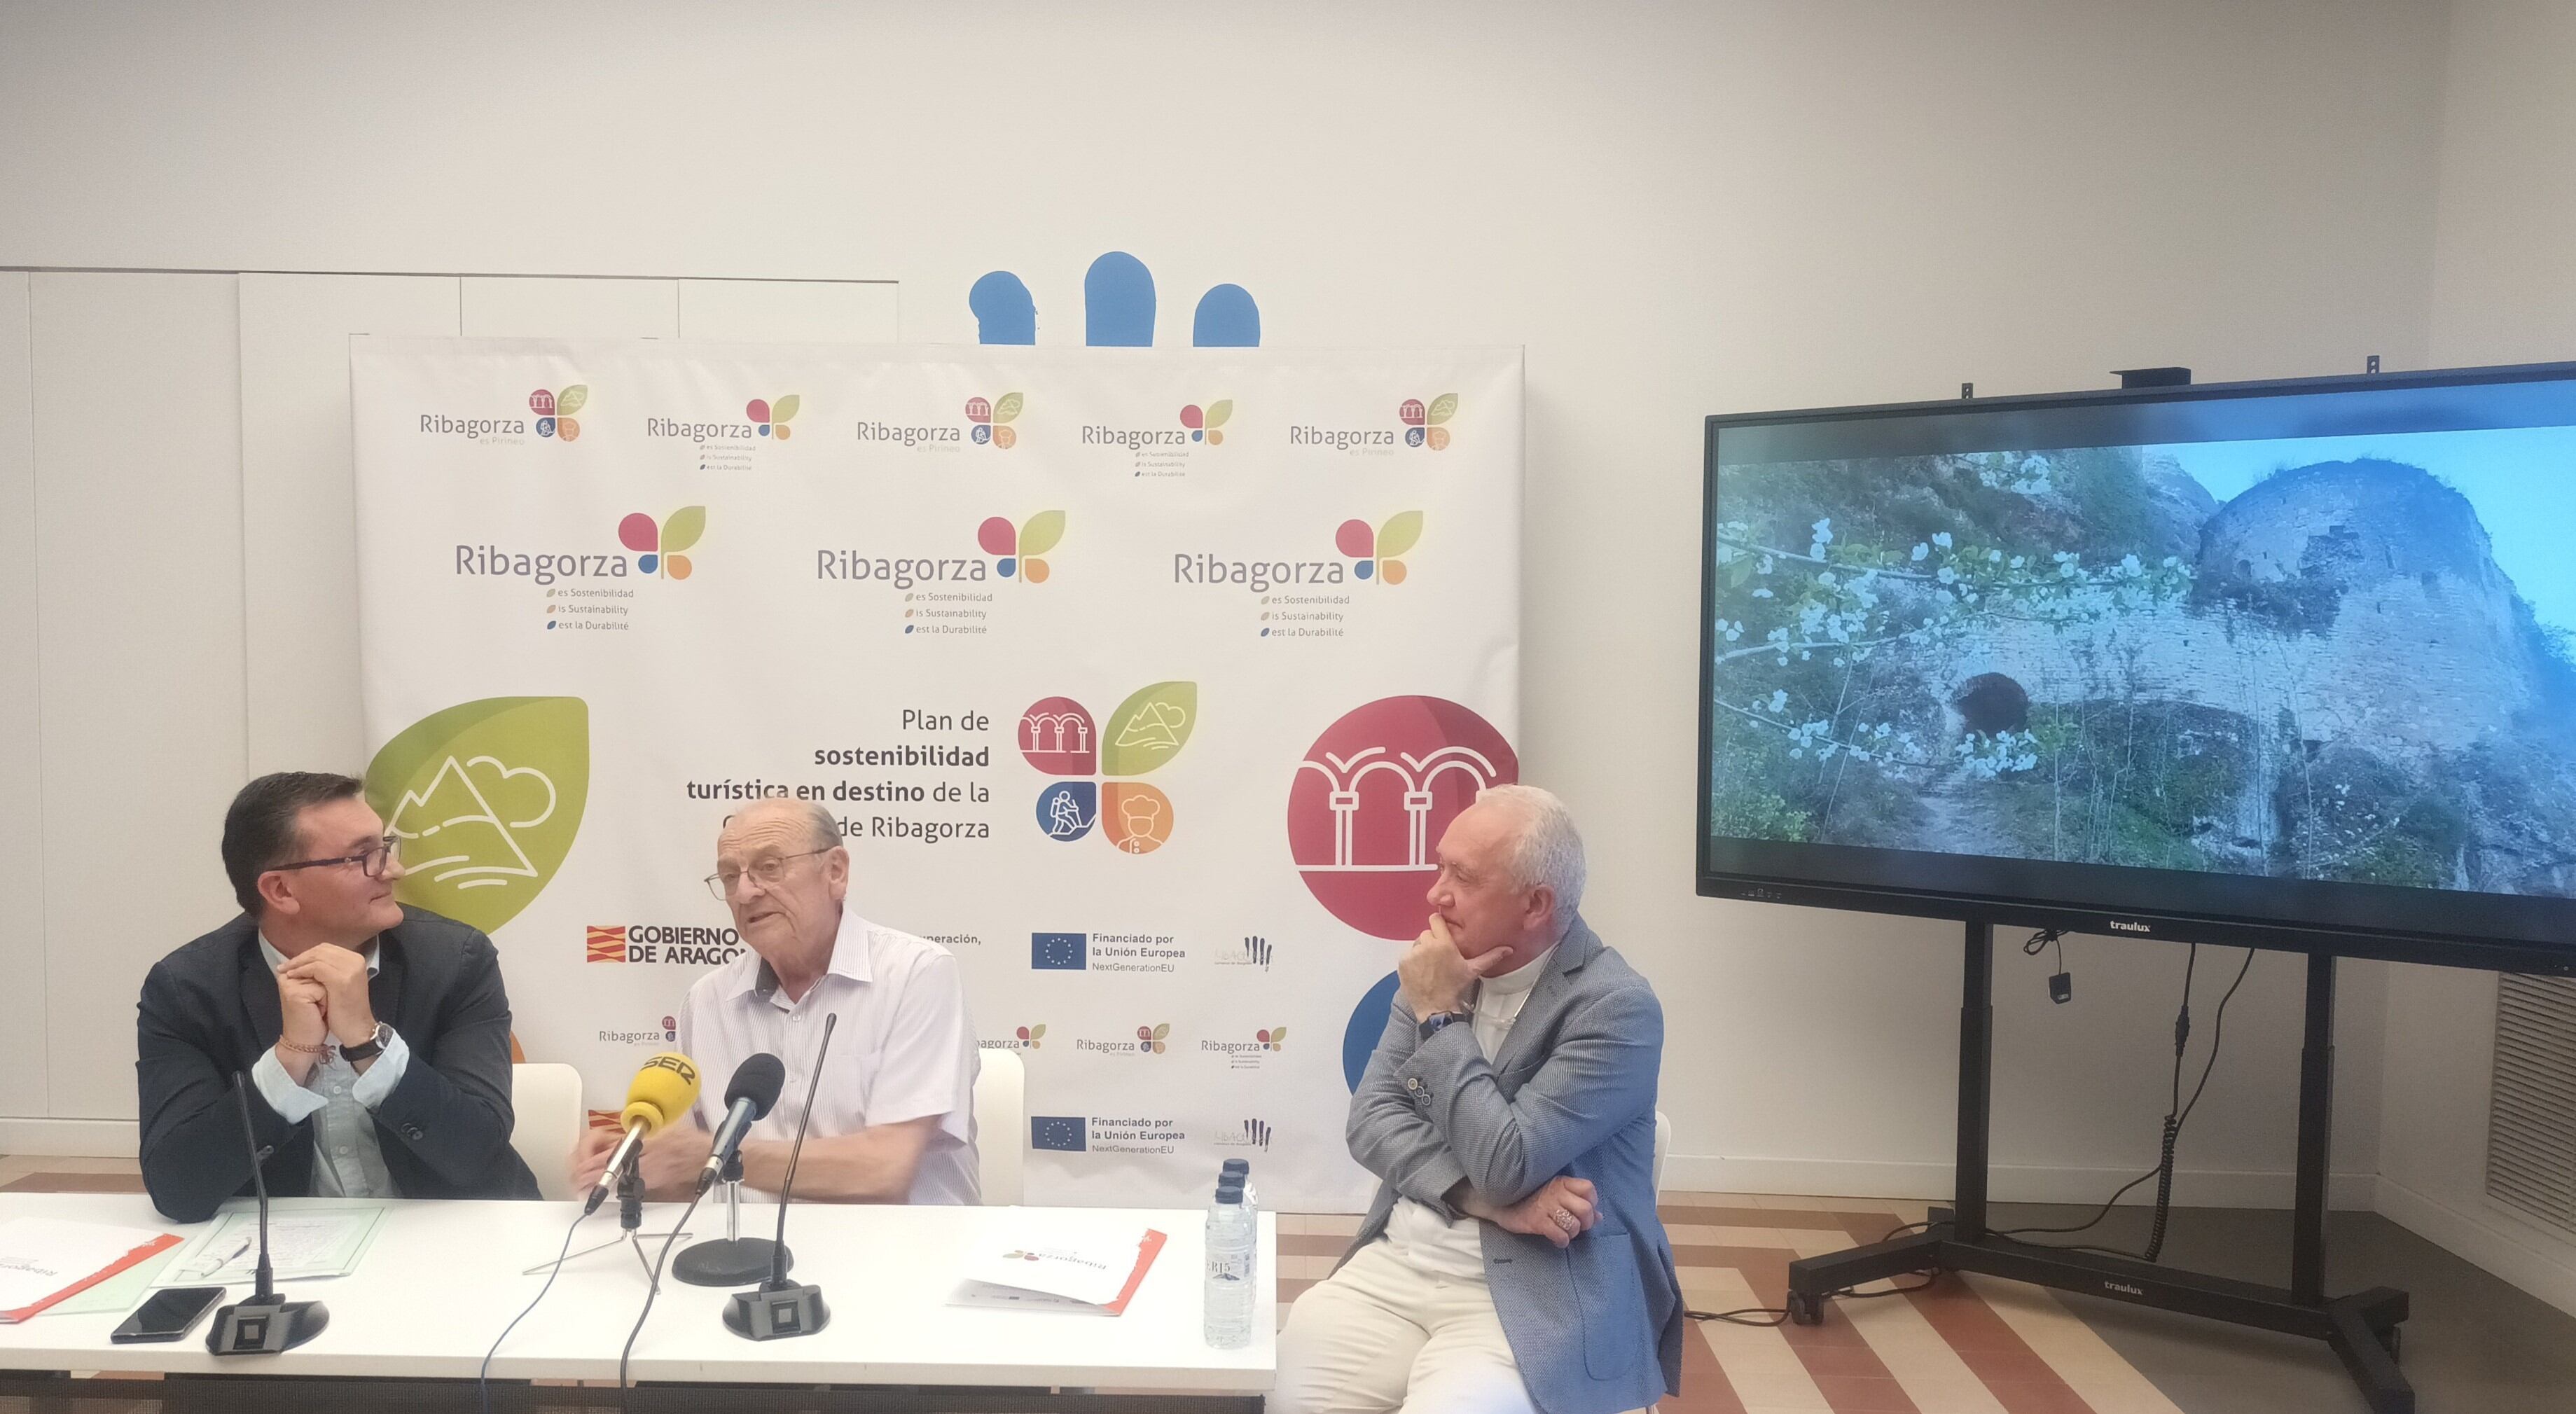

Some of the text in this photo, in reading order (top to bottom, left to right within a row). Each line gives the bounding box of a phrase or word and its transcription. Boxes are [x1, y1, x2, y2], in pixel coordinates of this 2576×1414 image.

[420, 414, 525, 439] Ribagorza
[647, 417, 752, 443] Ribagorza
[857, 422, 960, 447] Ribagorza
[1082, 425, 1186, 450] Ribagorza
[1290, 426, 1394, 450] Ribagorza
[929, 444, 961, 452] Pirineo
[456, 545, 628, 585] Ribagorza
[817, 550, 987, 590] Ribagorza
[1174, 553, 1344, 593] Ribagorza
[571, 588, 634, 598] Sostenibilidad
[928, 592, 992, 602] Sostenibilidad
[1284, 595, 1350, 604] Sostenibilidad
[569, 604, 628, 616] Sustainability
[926, 609, 987, 620] Sustainability
[1272, 612, 1344, 623] is Sustainability
[586, 621, 629, 630] Durabilité
[932, 625, 939, 634] la
[942, 625, 987, 634] Durabilité
[1287, 628, 1296, 637] la
[1299, 628, 1344, 637] Durabilité
[903, 709, 990, 731] Plan de
[815, 744, 990, 767] sostenibilidad
[686, 779, 990, 803] turística en destino de la
[838, 816, 990, 843] de Ribagorza
[2110, 920, 2151, 933] traulux
[628, 925, 740, 946] GOBIERNO
[1092, 932, 1175, 945] Financiado por
[629, 945, 747, 965] DE ARAGO
[1092, 946, 1186, 959] la Unión Europea
[1092, 962, 1175, 973] NextGenerationEU
[600, 1031, 660, 1044] Ribagorza
[977, 1039, 1020, 1049] agorza
[1076, 1039, 1135, 1053] Ribagorza
[1201, 1040, 1260, 1054] Ribagorza
[639, 1056, 696, 1086] SER
[1091, 1116, 1174, 1129] Financiado por
[1091, 1130, 1186, 1142] la Unión Europea
[1091, 1144, 1175, 1154] NextGenerationEU
[2104, 1280, 2144, 1296] traulux
